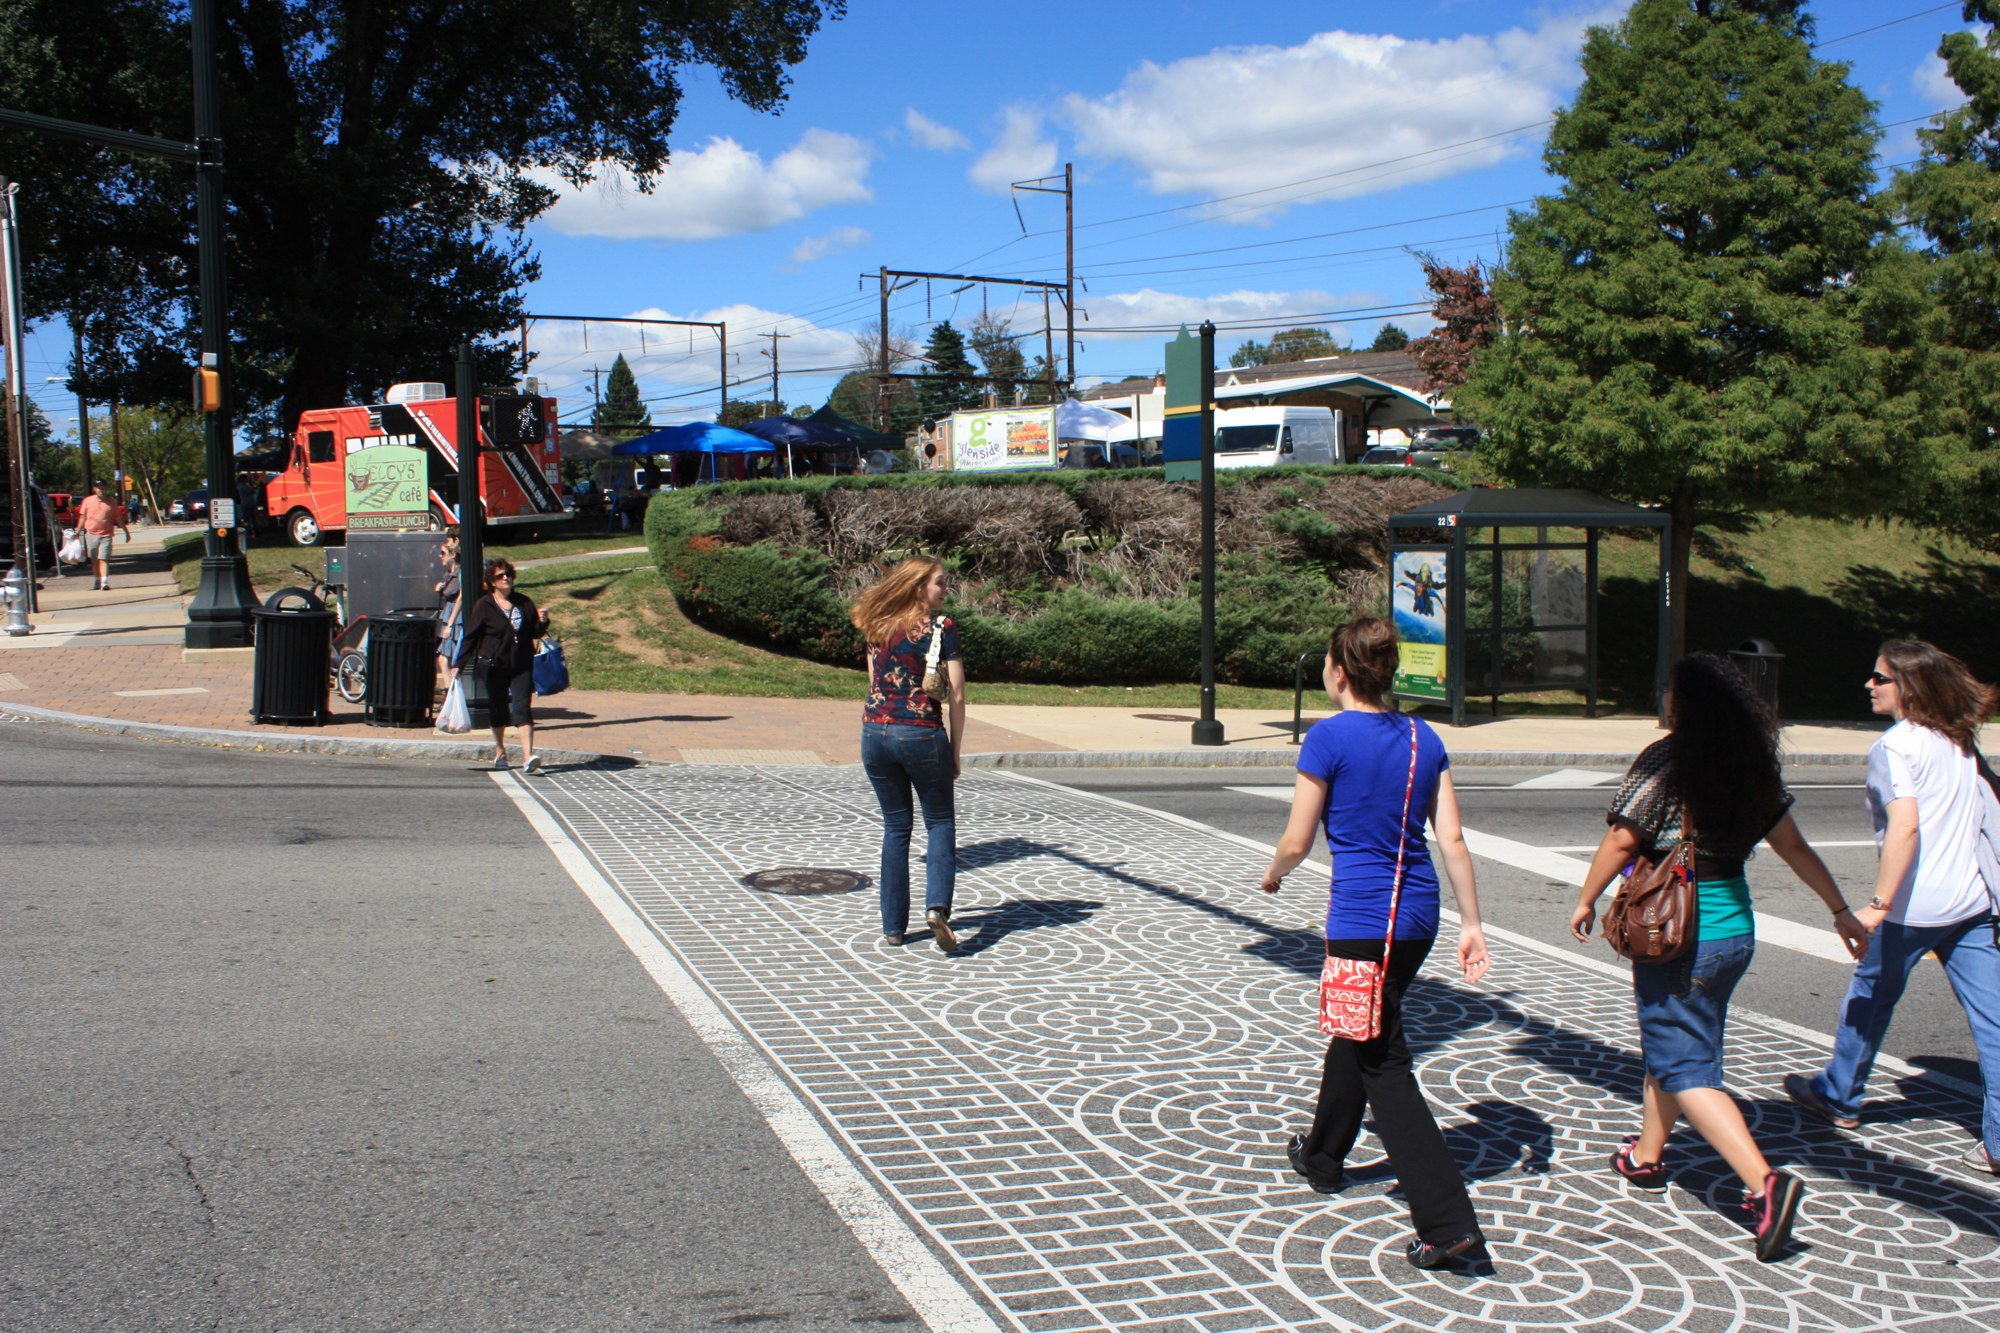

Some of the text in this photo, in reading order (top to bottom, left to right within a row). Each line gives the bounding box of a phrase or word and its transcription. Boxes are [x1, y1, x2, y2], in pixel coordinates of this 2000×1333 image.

[958, 442, 1000, 459] glenside
[369, 463, 415, 482] ELCY'S
[399, 486, 422, 502] café
[349, 516, 392, 529] BREAKFAST
[399, 515, 426, 527] LUNCH
[1437, 517, 1446, 526] 22
